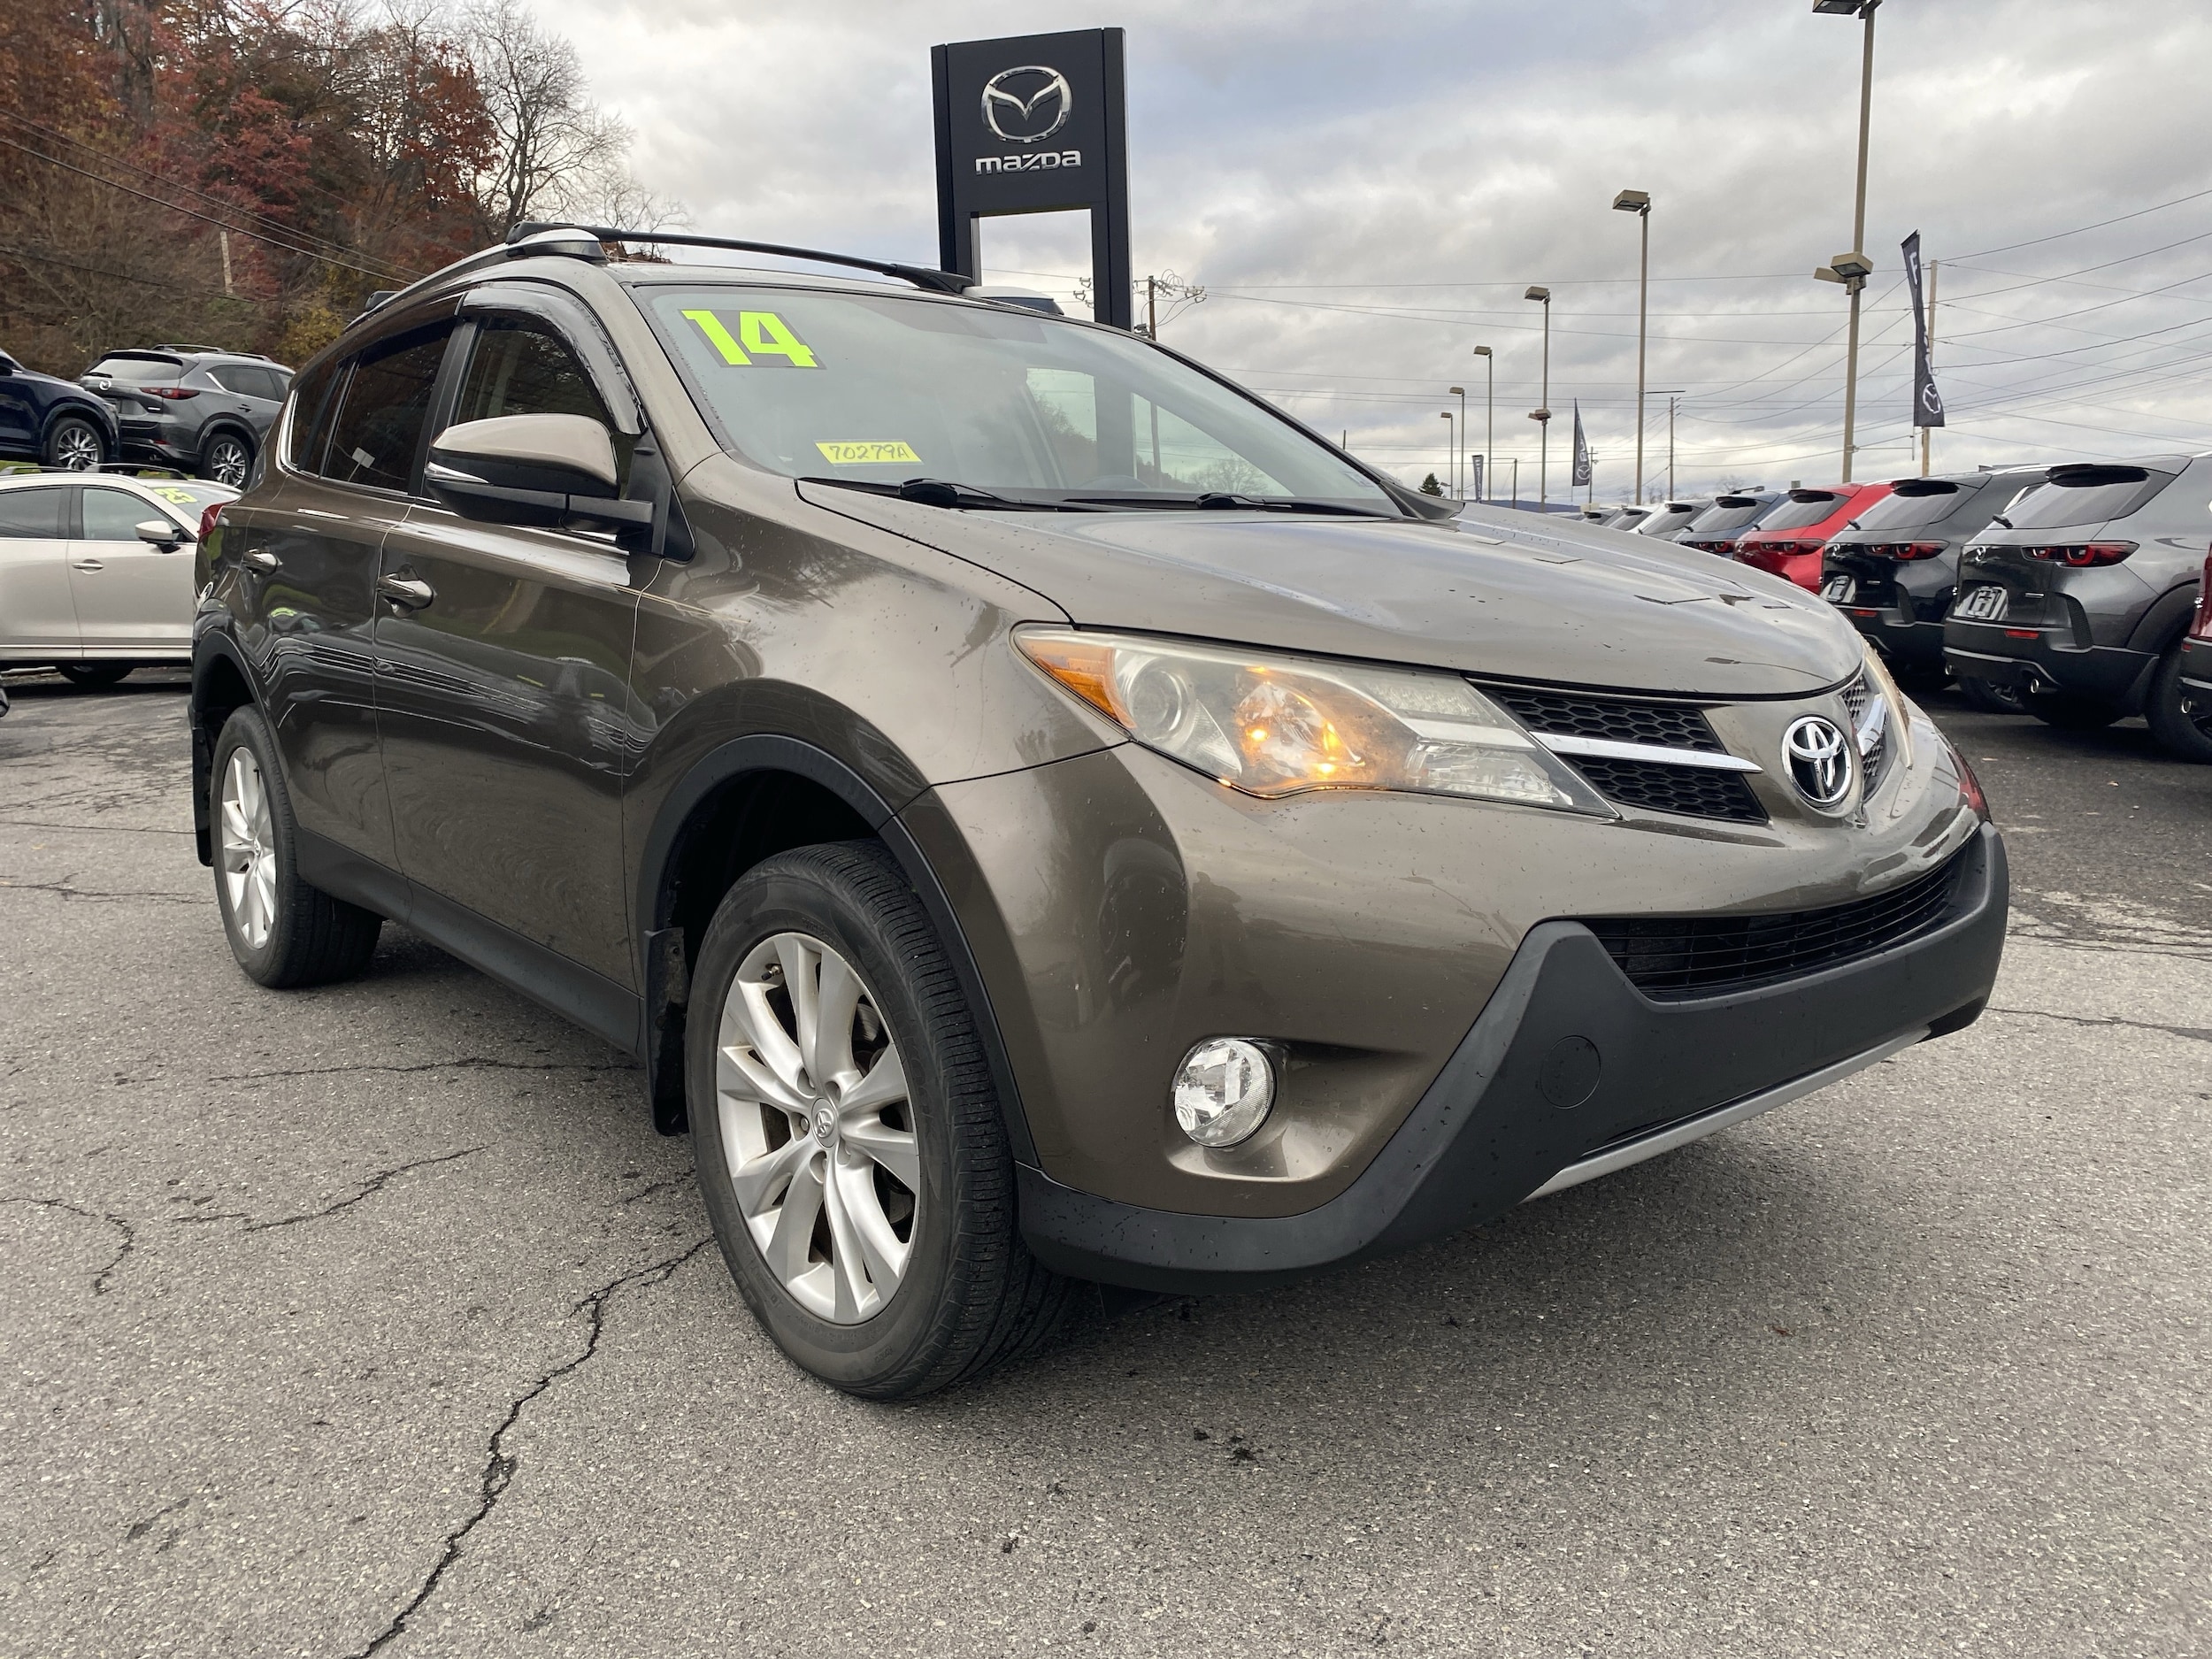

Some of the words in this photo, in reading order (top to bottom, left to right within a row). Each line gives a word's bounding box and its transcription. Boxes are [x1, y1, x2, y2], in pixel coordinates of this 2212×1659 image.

[975, 150, 1082, 175] mazda
[680, 310, 818, 367] 14
[829, 444, 910, 460] 70279A
